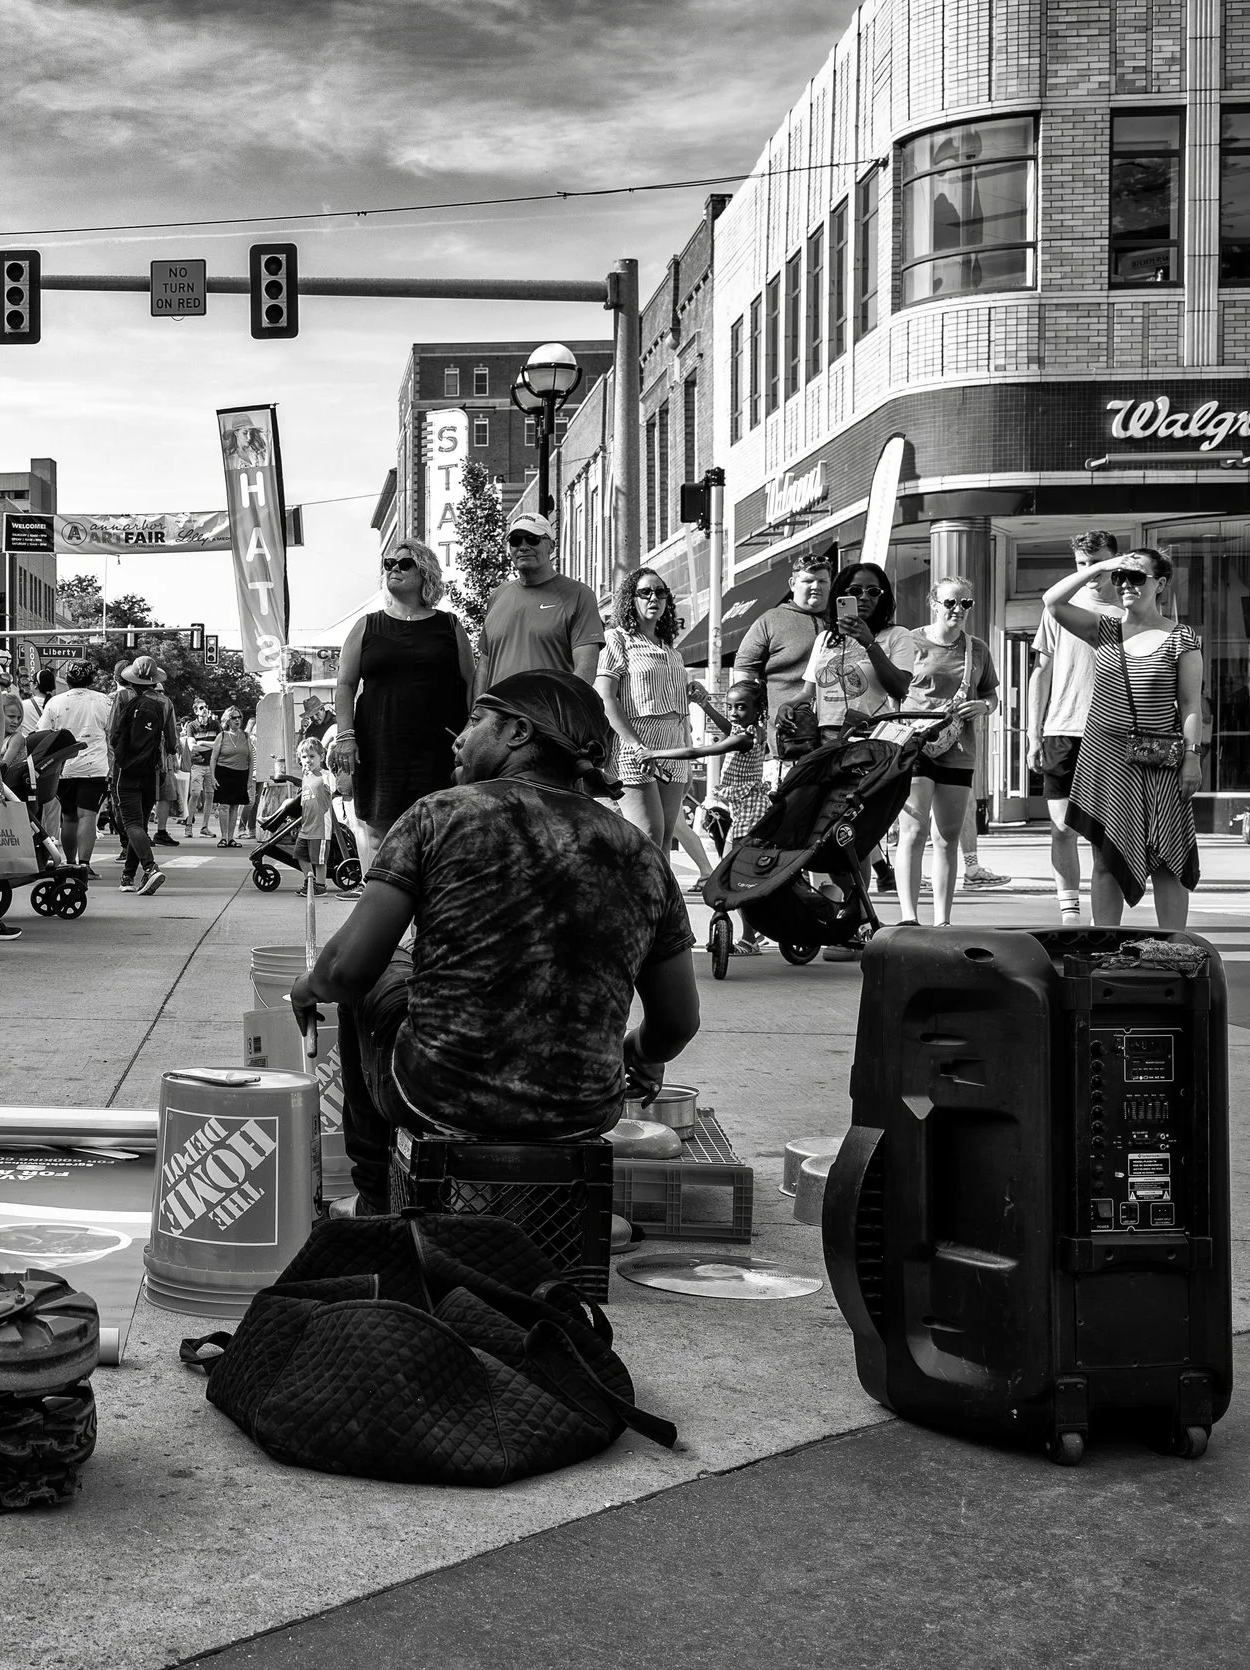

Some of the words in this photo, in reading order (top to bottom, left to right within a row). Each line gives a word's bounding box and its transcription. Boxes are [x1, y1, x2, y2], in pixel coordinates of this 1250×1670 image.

[168, 267, 188, 279] NO
[162, 282, 195, 294] TURN
[156, 297, 173, 310] ON
[177, 297, 201, 310] RED
[11, 522, 47, 530] WELCOME!
[43, 648, 77, 657] Liberty
[163, 1117, 229, 1188] DEPOT
[161, 1119, 277, 1236] HOME
[208, 1181, 265, 1231] THE
